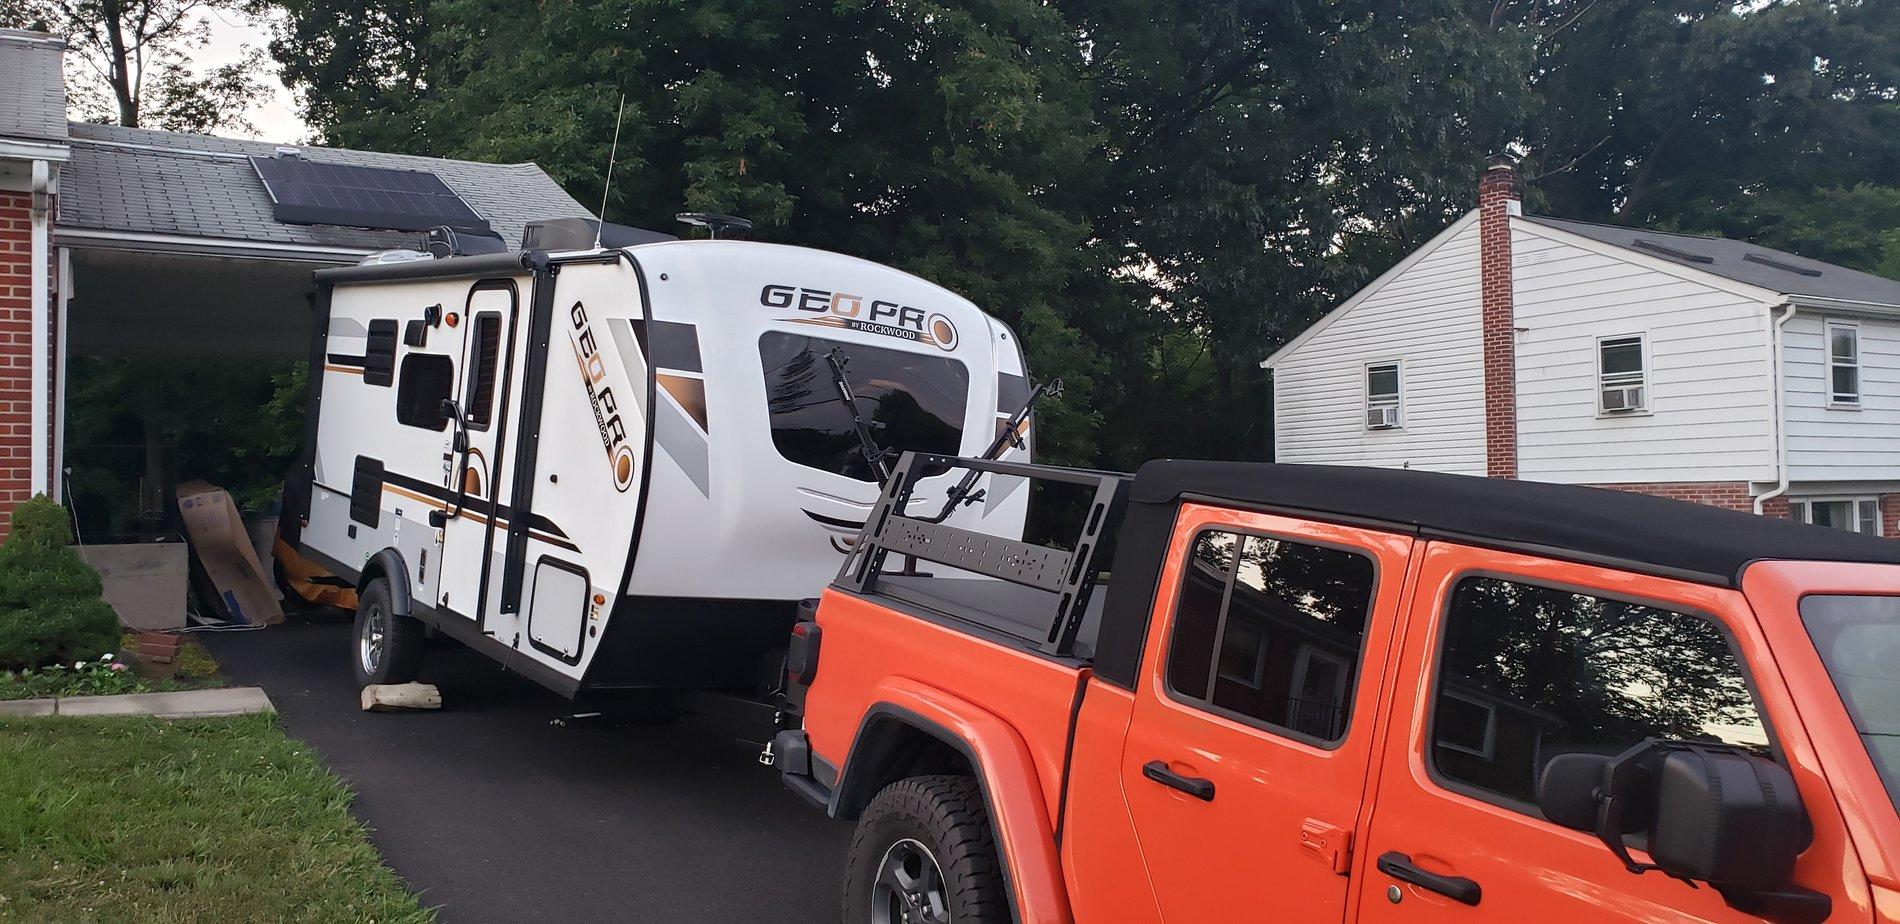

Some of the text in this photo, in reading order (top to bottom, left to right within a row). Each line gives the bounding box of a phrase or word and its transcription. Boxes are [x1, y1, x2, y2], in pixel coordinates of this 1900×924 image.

[760, 284, 862, 318] GEO
[570, 300, 606, 384] GEO
[860, 322, 916, 340] ROCKWOOD
[590, 392, 610, 447] ROCKWOOD
